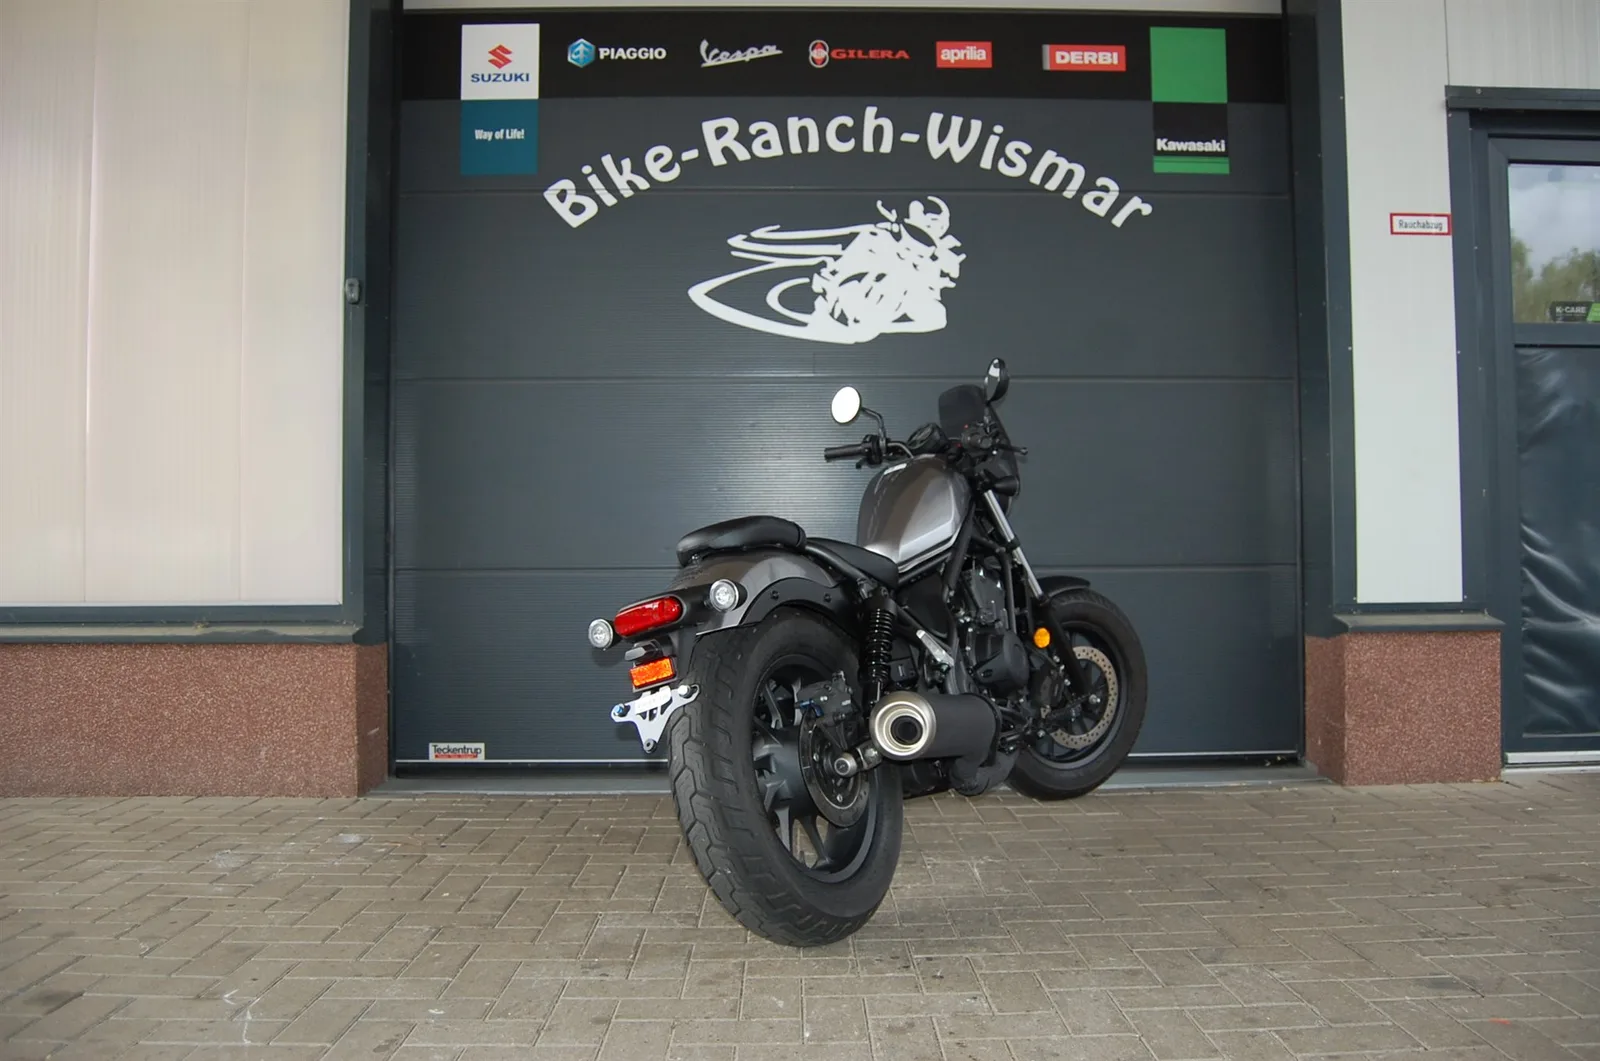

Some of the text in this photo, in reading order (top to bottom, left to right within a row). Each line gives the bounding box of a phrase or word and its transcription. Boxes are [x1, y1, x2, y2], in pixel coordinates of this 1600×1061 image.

[599, 47, 667, 60] PIAGGIO
[700, 39, 783, 67] Vespa
[830, 48, 910, 60] GILERA
[940, 46, 986, 64] aprilia
[1055, 51, 1119, 65] DERBI
[470, 72, 530, 84] SUZUKI
[474, 128, 525, 142] Way of Life!
[1156, 138, 1226, 153] Kawasaki
[543, 106, 1152, 228] Bike-Ranch-Wismar
[1398, 219, 1443, 232] Rauchabzug
[1555, 306, 1587, 314] K-CARE
[432, 745, 482, 755] Teckentrup
